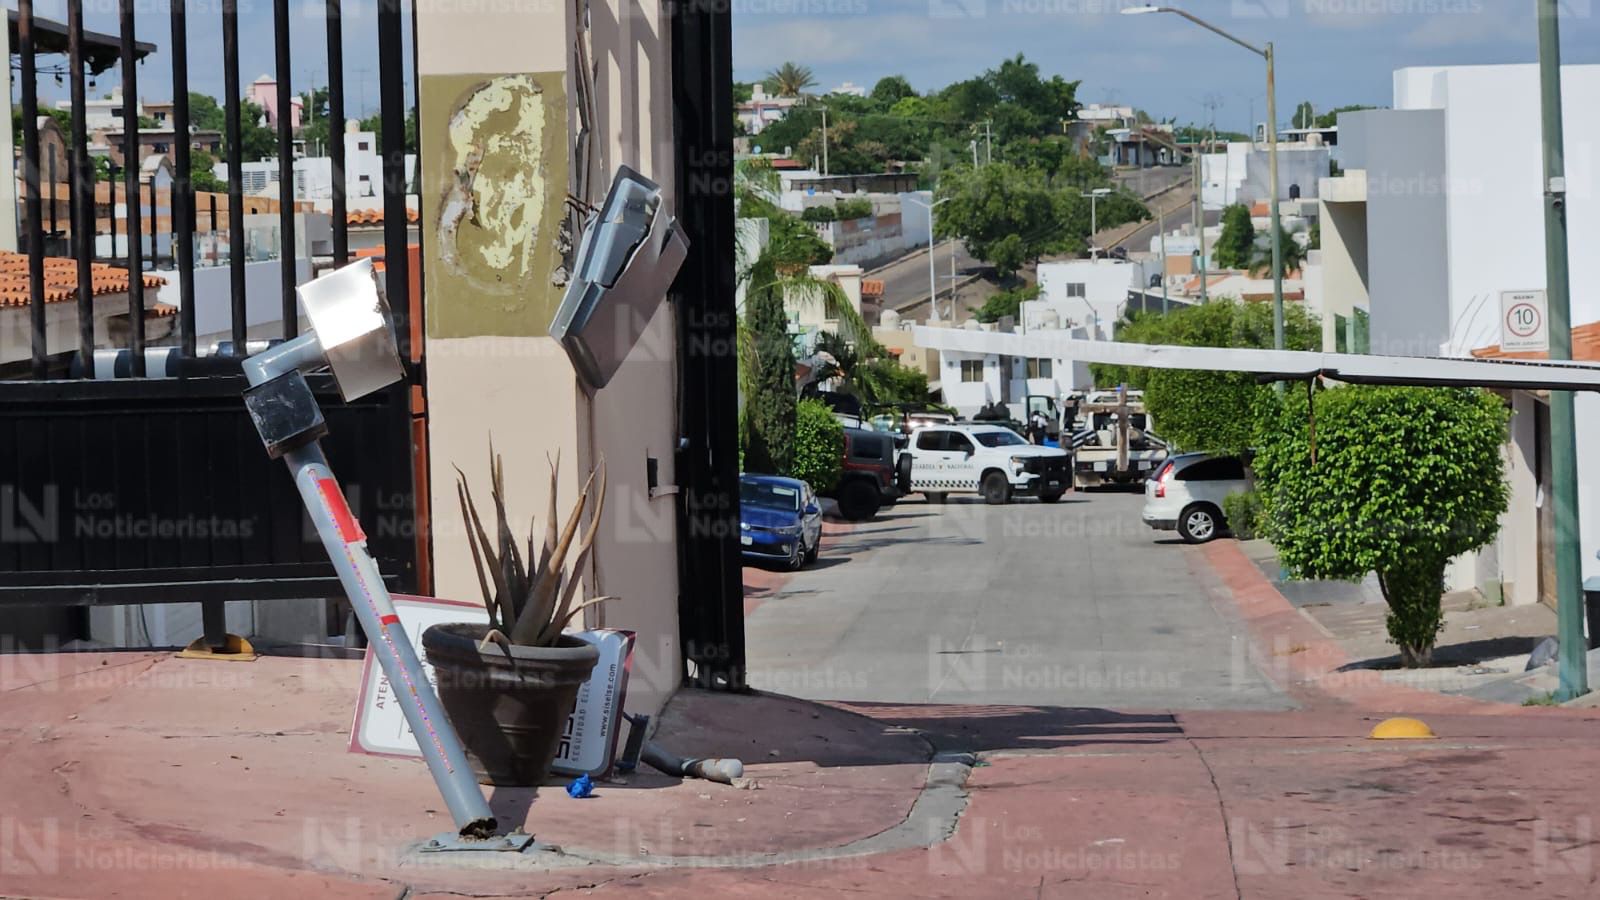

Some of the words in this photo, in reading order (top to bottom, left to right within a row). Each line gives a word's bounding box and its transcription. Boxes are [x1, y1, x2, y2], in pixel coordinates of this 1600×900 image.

[1514, 309, 1533, 325] 10
[376, 675, 390, 710] ATEN
[600, 663, 617, 737] www.siselse.com
[571, 709, 586, 762] SEGURIDAD
